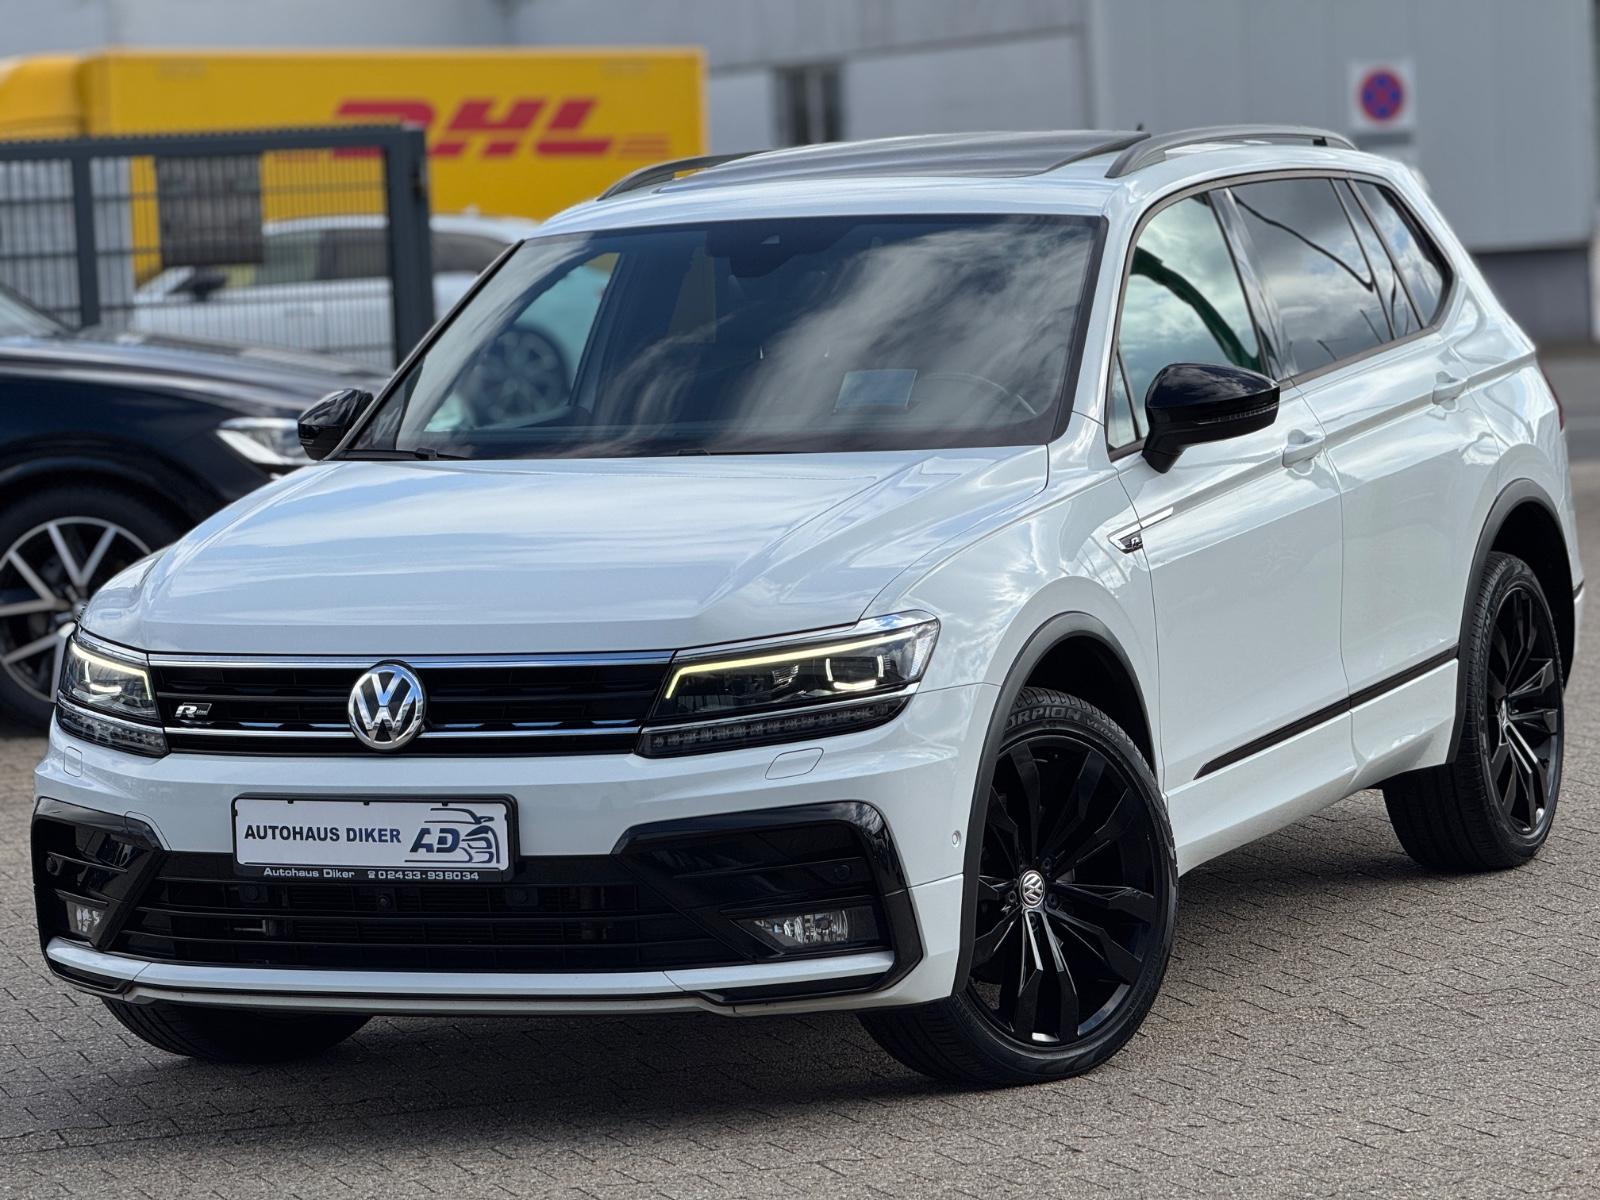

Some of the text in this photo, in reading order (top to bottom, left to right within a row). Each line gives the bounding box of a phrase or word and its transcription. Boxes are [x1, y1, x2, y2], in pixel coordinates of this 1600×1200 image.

[332, 98, 614, 157] DHL
[351, 664, 423, 747] VW
[244, 825, 401, 843] AUTOHAUS DIKER
[410, 827, 461, 853] AD
[263, 867, 479, 881] Autohaus Diker 02433-938034
